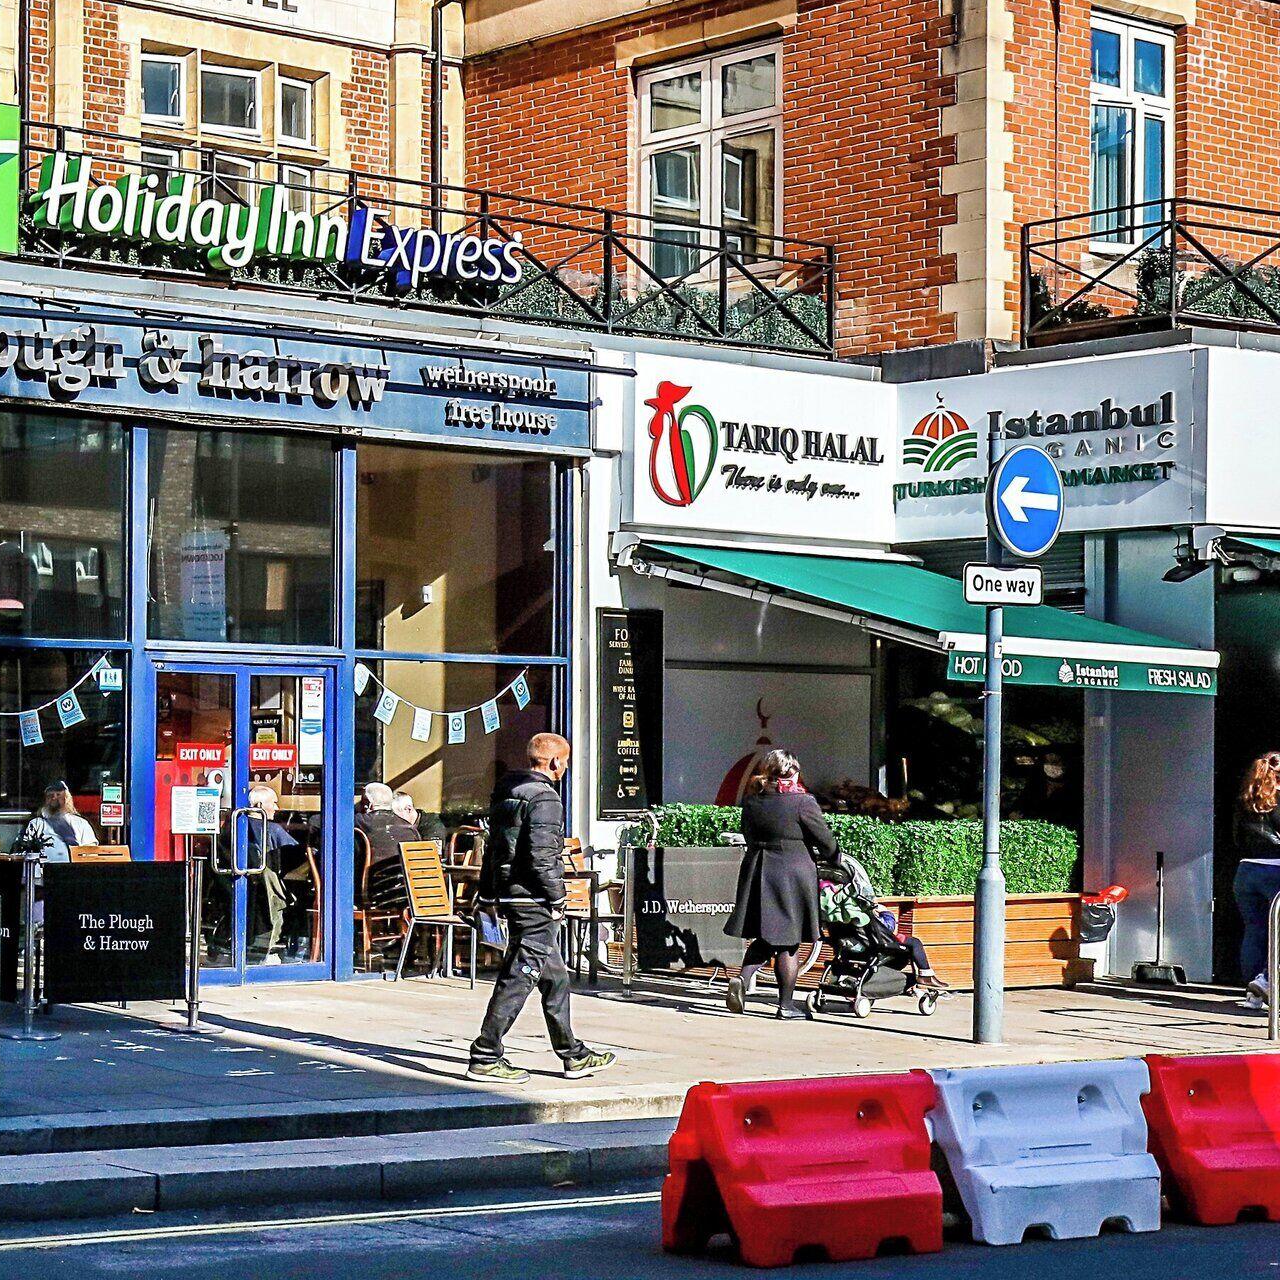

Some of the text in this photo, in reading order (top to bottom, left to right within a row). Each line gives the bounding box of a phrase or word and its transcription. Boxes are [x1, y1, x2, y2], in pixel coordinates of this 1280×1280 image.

[41, 151, 524, 291] Holiday Inn Express
[139, 328, 191, 388] &
[198, 334, 391, 404] harrow
[425, 362, 558, 399] wetherspoon
[447, 397, 558, 431] free house
[986, 391, 1175, 441] Istanbul
[720, 421, 885, 466] TARIQ HALAL
[1044, 431, 1176, 460] GANIC
[721, 464, 765, 490] There
[767, 474, 783, 493] is
[785, 473, 819, 501] only
[894, 460, 1177, 501] TURKISH RMARKET
[972, 574, 1035, 597] One way
[614, 628, 629, 641] FO
[608, 640, 629, 649] SERVED
[618, 659, 634, 667] FAM
[954, 656, 982, 675] HOT
[1075, 662, 1119, 679] Istanbul
[1075, 677, 1120, 687] ORGANIC
[1148, 668, 1212, 690] FRESH SALAD
[612, 685, 627, 693] WIDE
[179, 748, 222, 761] EXIT ONLY
[252, 748, 294, 761] EXIT ONLY
[617, 747, 640, 756] COFFEE
[641, 900, 665, 914] J.D.
[78, 913, 154, 932] The Plough
[83, 935, 150, 951] & Harrow
